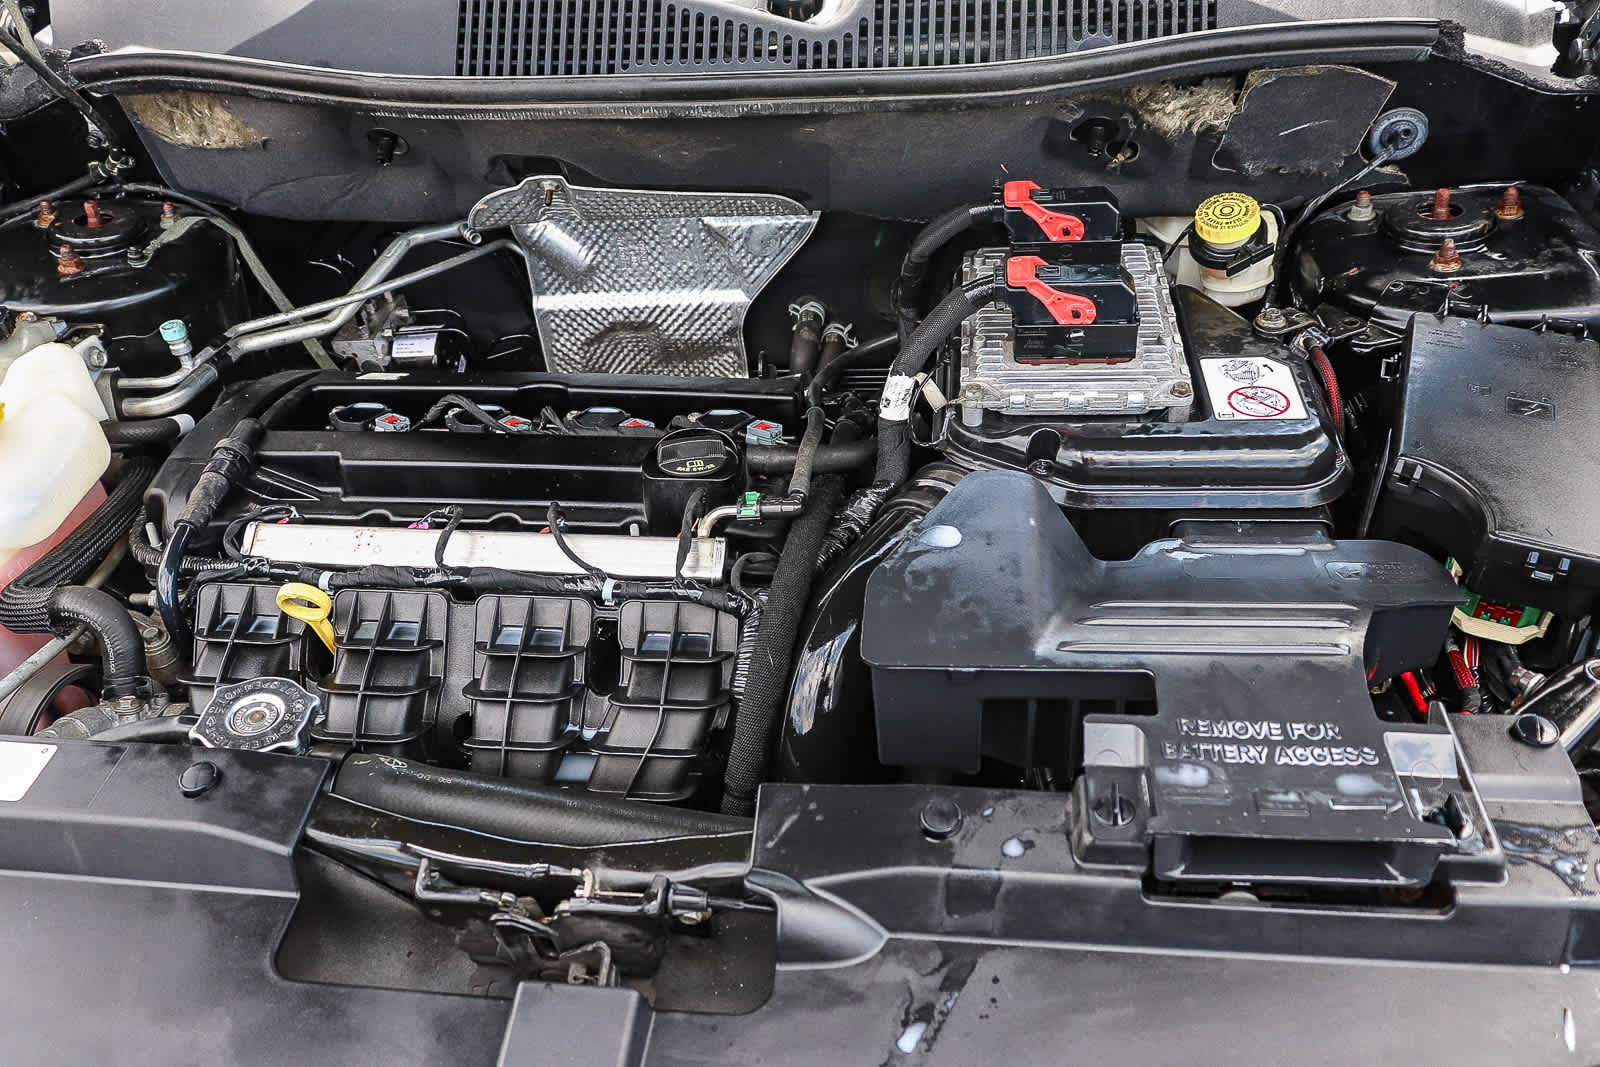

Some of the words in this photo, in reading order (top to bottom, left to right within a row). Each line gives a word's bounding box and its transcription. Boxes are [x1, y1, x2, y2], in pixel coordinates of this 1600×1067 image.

[1177, 717, 1284, 741] REMOVE
[1289, 721, 1343, 742] FOR
[1162, 740, 1269, 765] BATTERY
[1274, 744, 1379, 767] ACCESS
